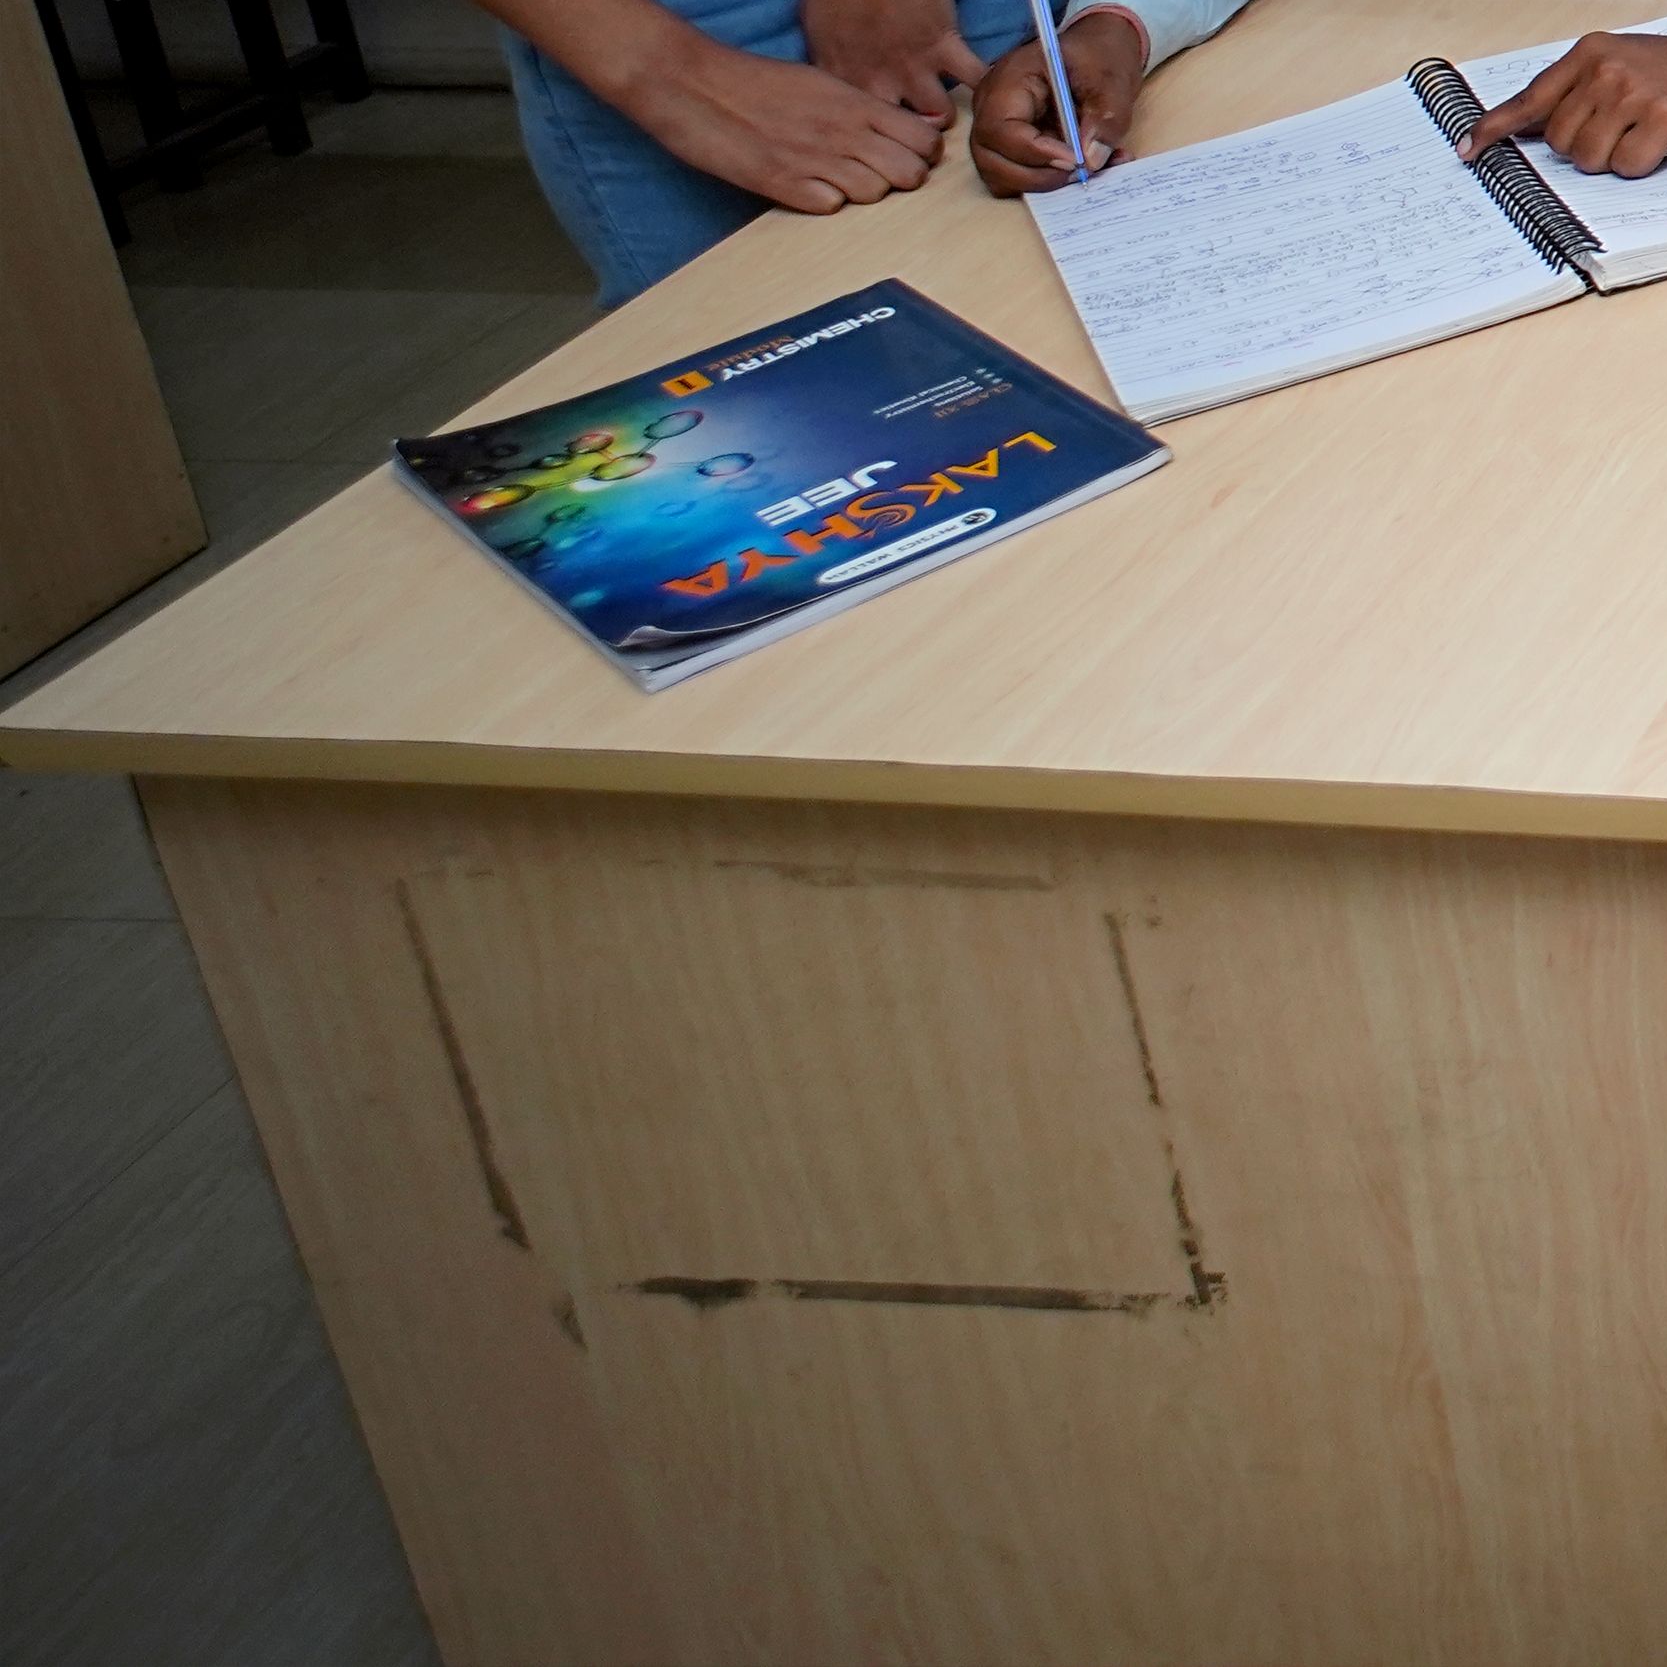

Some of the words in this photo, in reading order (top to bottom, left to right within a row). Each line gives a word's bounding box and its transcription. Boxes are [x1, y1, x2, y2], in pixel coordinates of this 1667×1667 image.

[722, 306, 896, 382] CHEMISTRY
[660, 431, 1057, 597] LAKSHYA
[755, 460, 898, 528] JEE
[824, 552, 893, 581] WALLAH
[897, 524, 960, 552] PHYSICS
